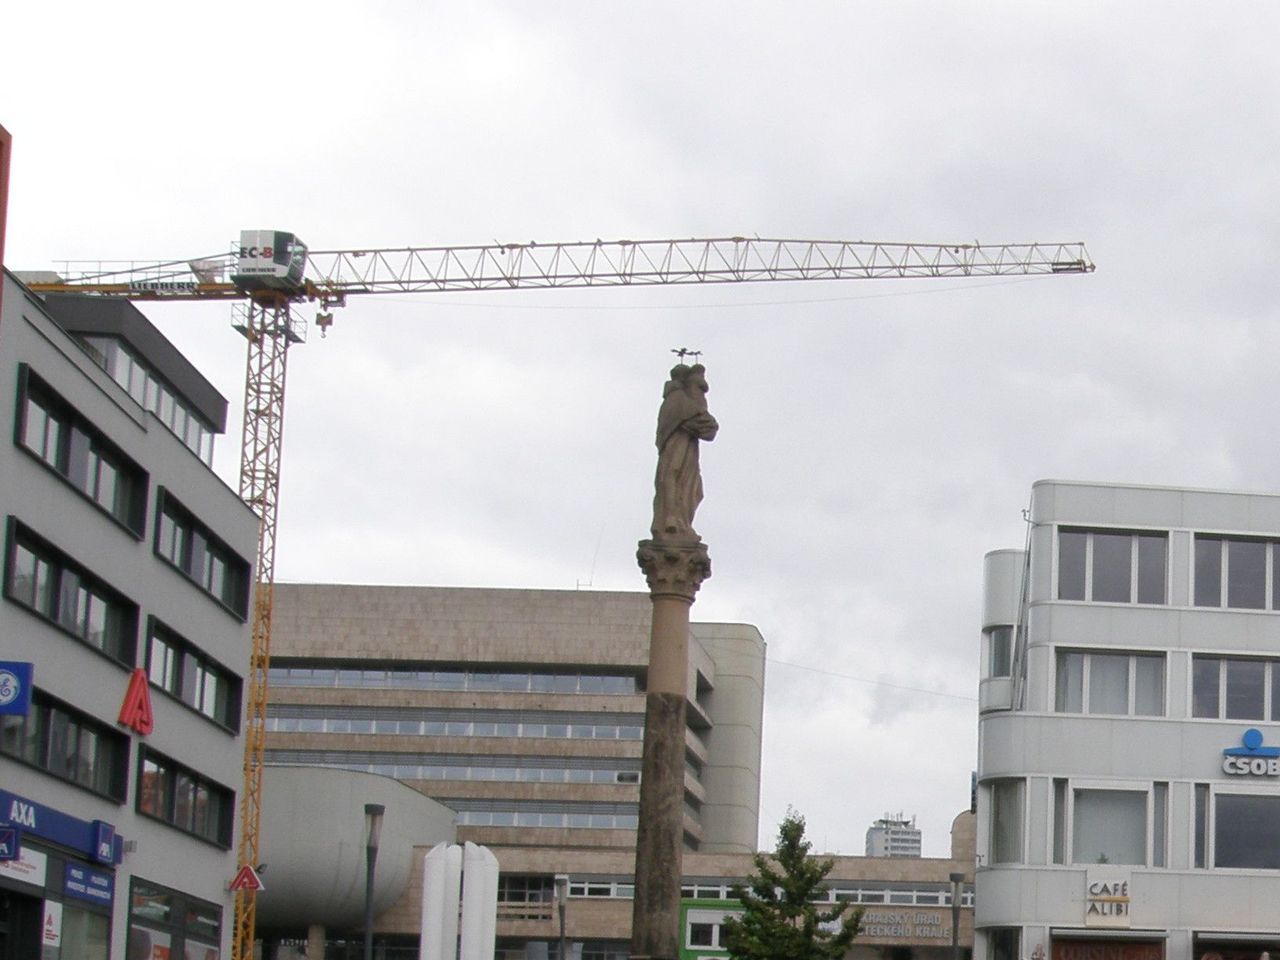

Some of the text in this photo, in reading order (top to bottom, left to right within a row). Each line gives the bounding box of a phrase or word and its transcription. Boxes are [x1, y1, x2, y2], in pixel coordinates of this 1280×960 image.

[240, 247, 273, 259] EC-B
[131, 281, 197, 291] LIEBHERR
[1223, 756, 1280, 775] ČSOB
[10, 800, 36, 829] AXA
[1089, 881, 1128, 896] CAFÉ
[1088, 903, 1128, 916] ALIBI
[916, 926, 950, 938] KRAJE
